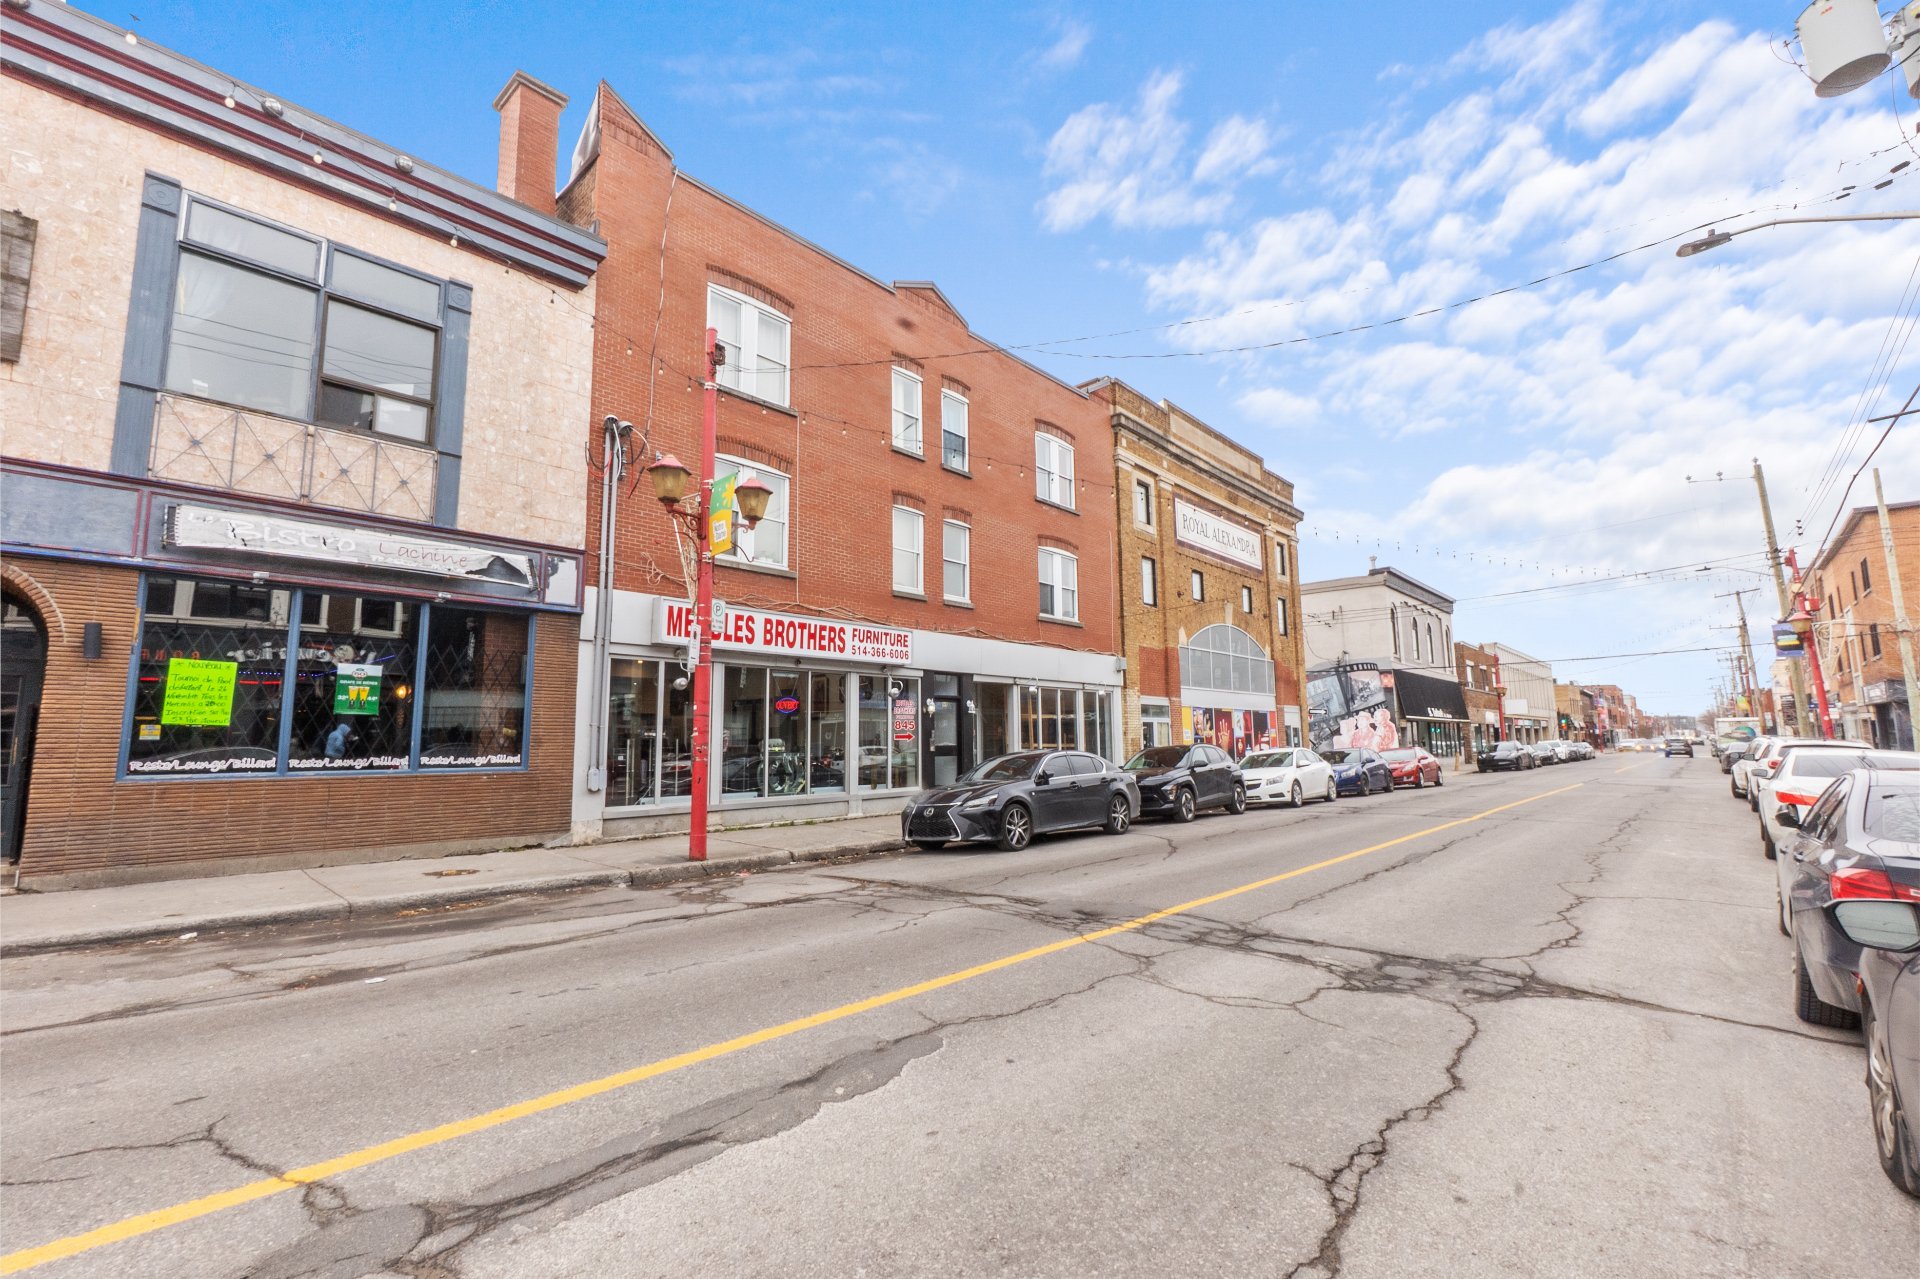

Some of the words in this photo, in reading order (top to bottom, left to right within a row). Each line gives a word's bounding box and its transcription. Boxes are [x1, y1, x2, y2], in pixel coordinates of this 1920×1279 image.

[221, 517, 356, 552] Bistro
[1182, 513, 1210, 539] ROYAL
[1212, 528, 1256, 558] ALEXANDRA
[379, 542, 467, 567] Lachine
[667, 605, 755, 645] MELES
[763, 617, 846, 654] BROTHERS
[852, 627, 909, 648] FURNITURE
[852, 645, 909, 660] 514-366-6006
[894, 720, 916, 731] 845
